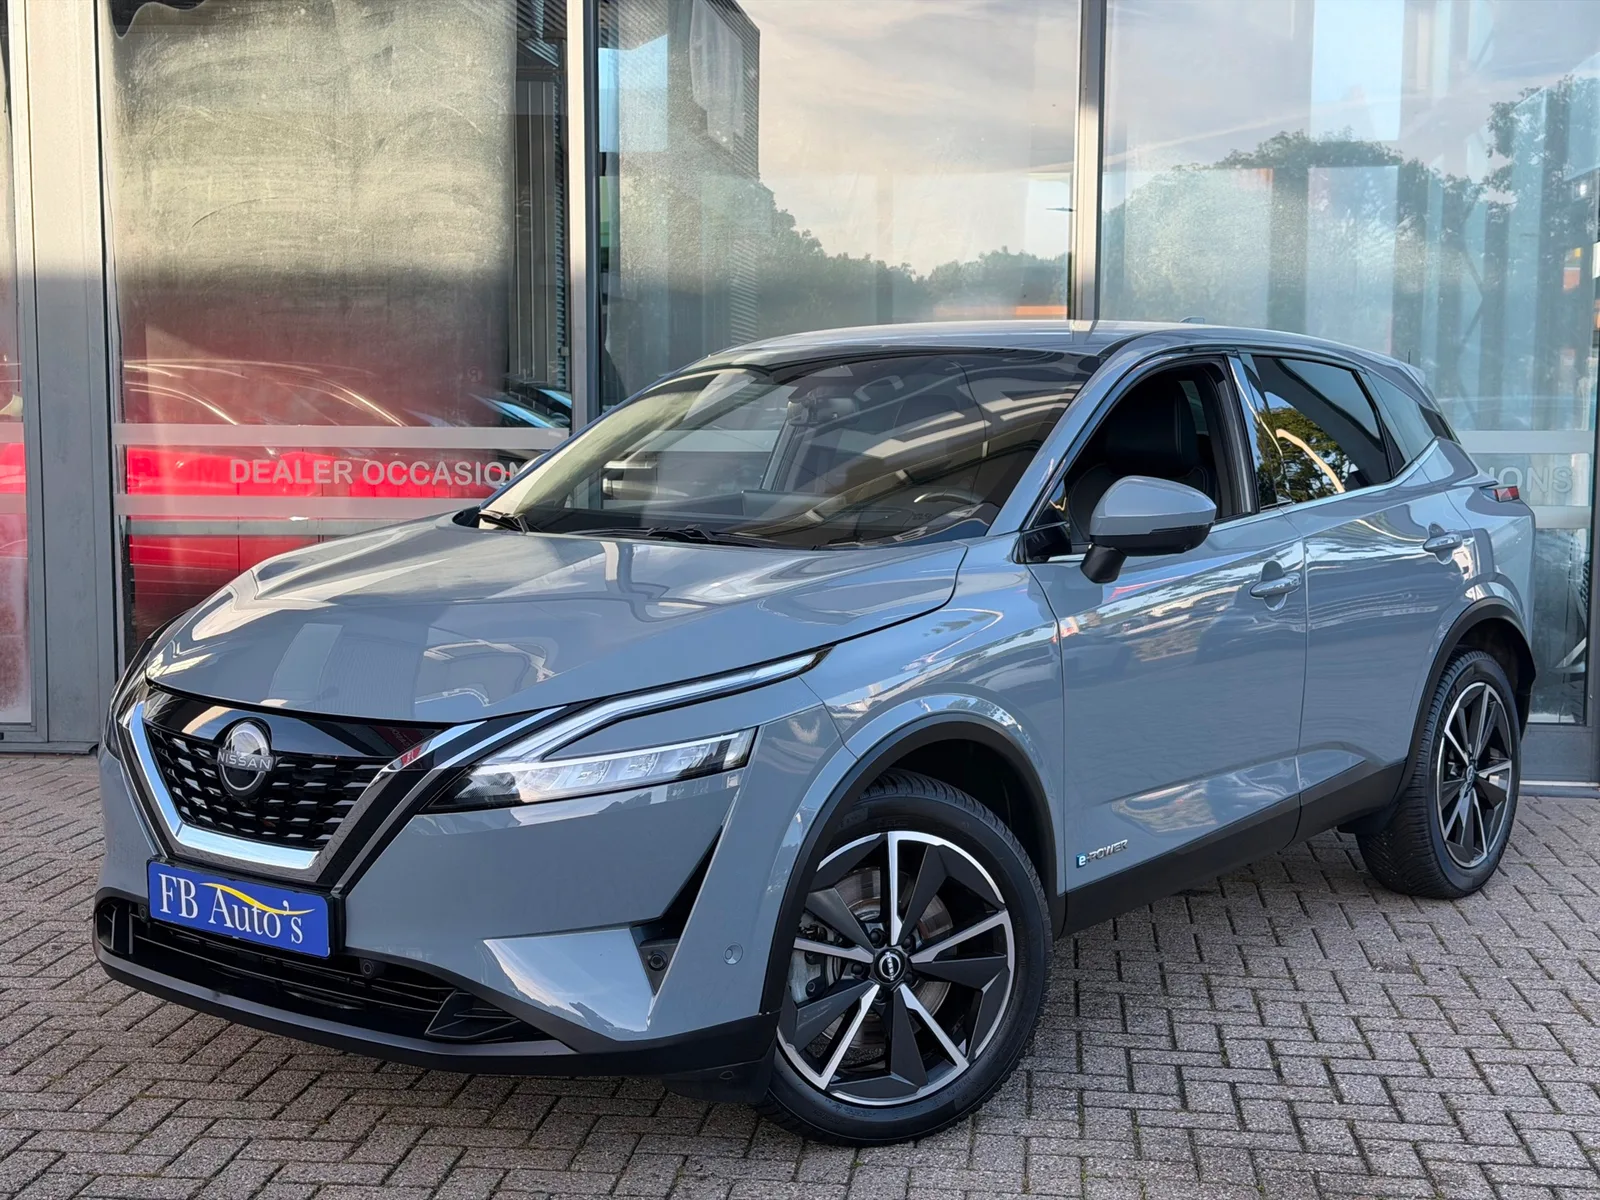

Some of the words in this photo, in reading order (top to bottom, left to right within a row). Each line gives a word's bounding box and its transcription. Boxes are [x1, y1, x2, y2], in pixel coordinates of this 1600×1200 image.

[230, 459, 353, 484] DEALER
[217, 751, 271, 769] NISSAN
[158, 873, 199, 919] FB
[208, 887, 303, 944] Auto's
